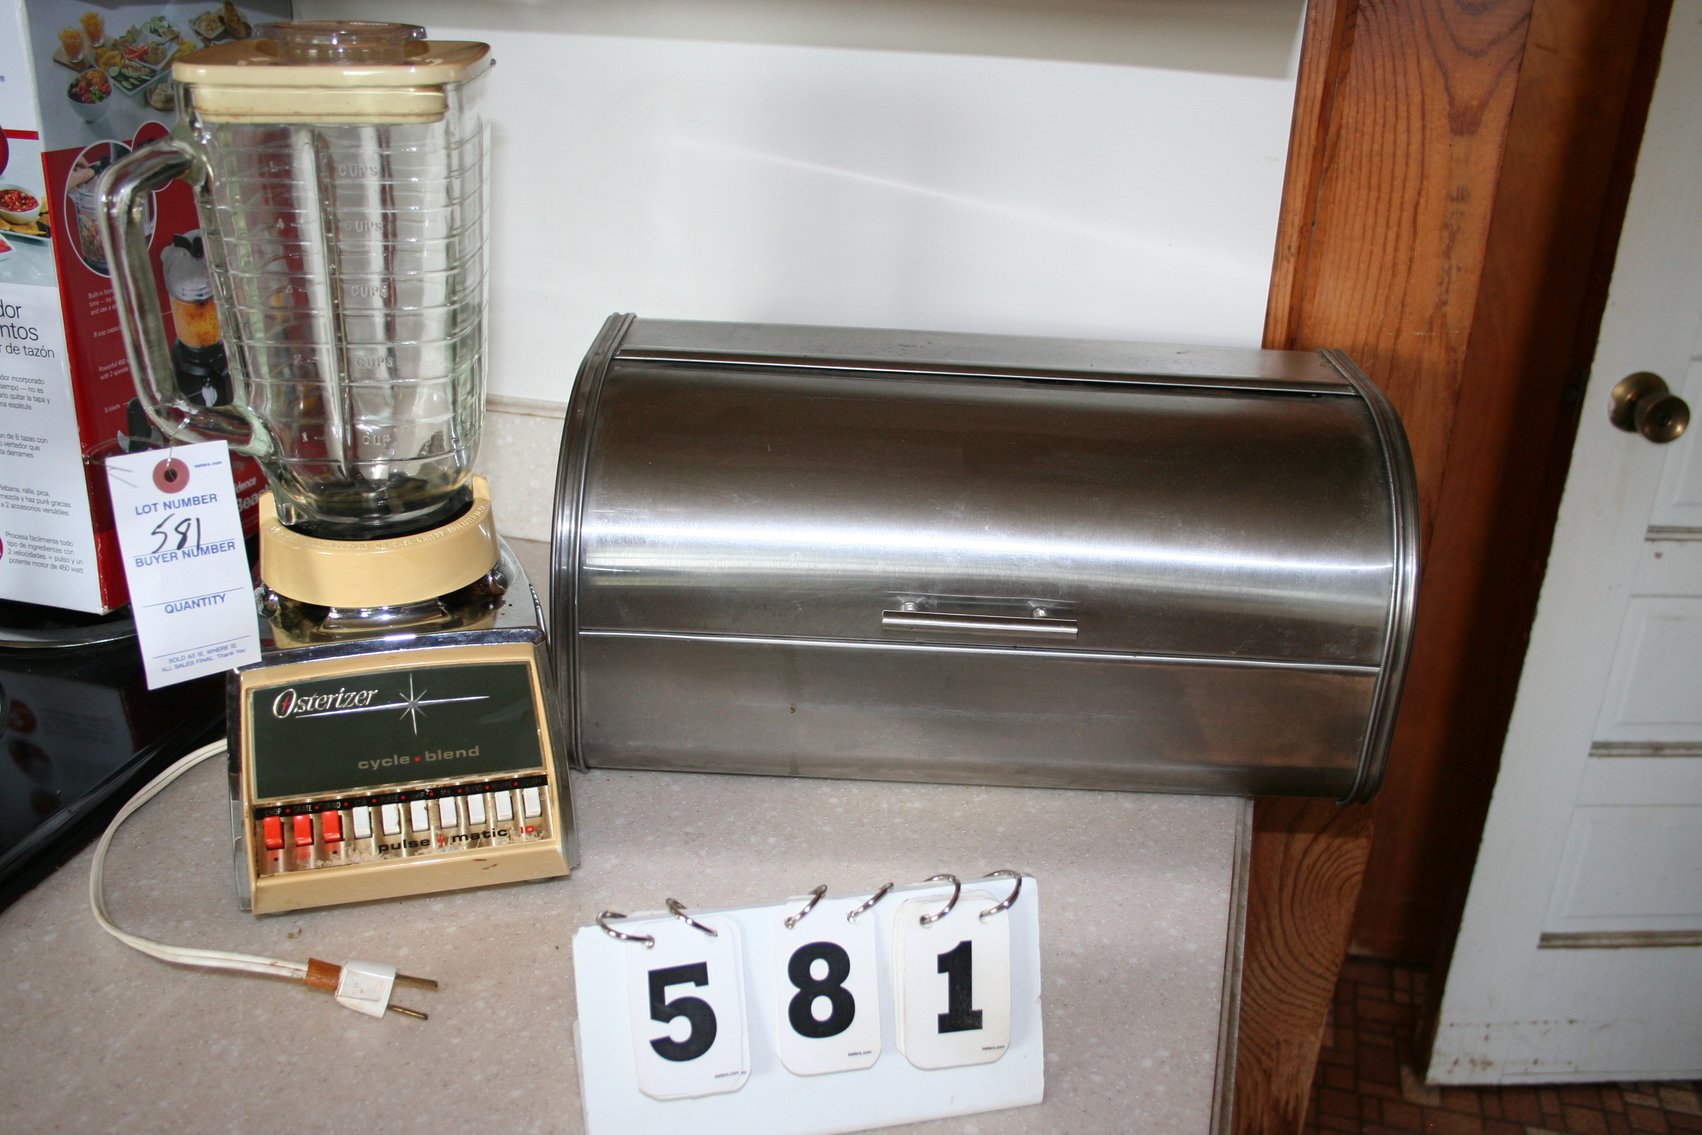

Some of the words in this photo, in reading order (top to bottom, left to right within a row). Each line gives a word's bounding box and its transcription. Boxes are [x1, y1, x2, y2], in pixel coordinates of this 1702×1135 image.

[0, 299, 22, 319] dor
[0, 322, 39, 341] ntos
[6, 342, 20, 355] de
[23, 345, 55, 359] tazón
[11, 376, 45, 385] incorporado
[135, 502, 159, 515] LOT
[163, 493, 218, 511] NUMBER
[5, 530, 28, 541] Procesa
[60, 539, 74, 547] todo
[151, 512, 201, 554] 581
[6, 541, 18, 549] tipo
[28, 544, 63, 555] ingredientes
[7, 547, 12, 555] 2
[135, 551, 179, 568] BUYER
[182, 541, 236, 560] NUMBER
[31, 560, 49, 569] motor
[59, 563, 70, 572] 450
[164, 593, 227, 614] QUANTITY
[168, 654, 187, 664] SOLD
[206, 645, 229, 655] WHERE
[174, 661, 195, 670] SALES
[272, 687, 379, 720] Osterizer
[358, 755, 411, 771] cycle
[424, 745, 480, 762] blend
[378, 838, 431, 854] pulse
[452, 828, 508, 843] matic
[648, 961, 718, 1062] 5
[788, 941, 856, 1039] 8
[937, 940, 983, 1034] 1
